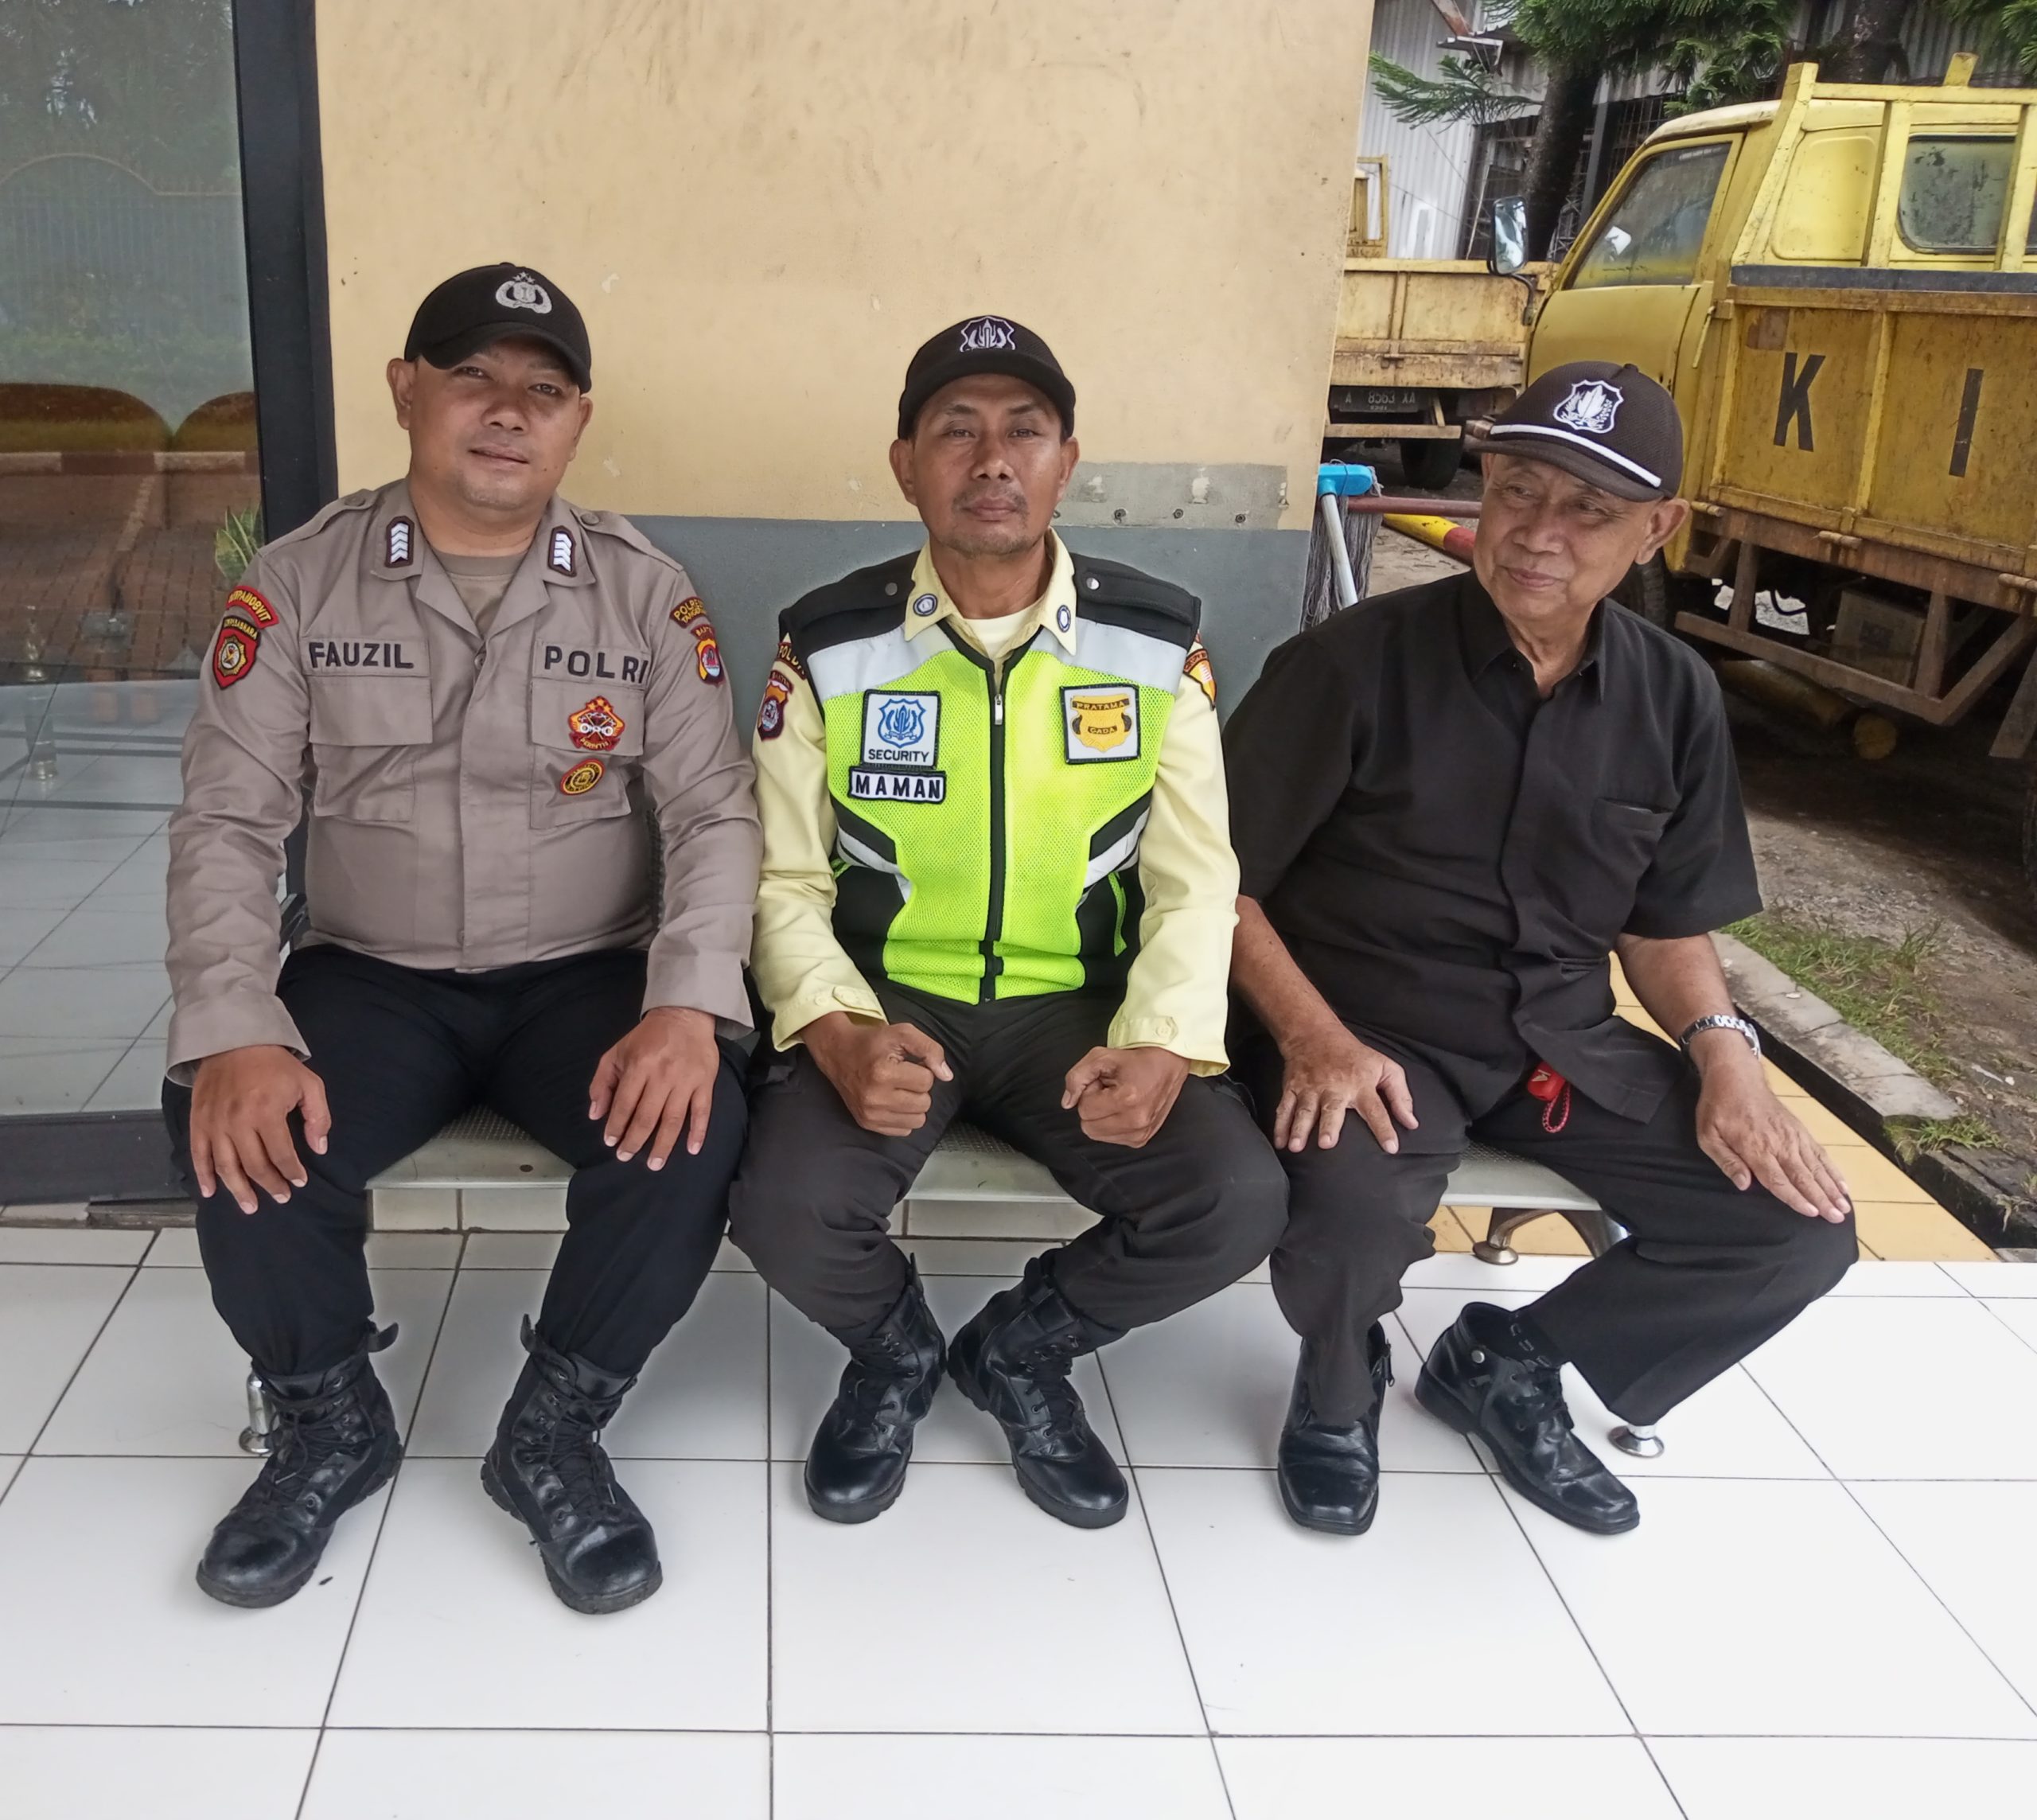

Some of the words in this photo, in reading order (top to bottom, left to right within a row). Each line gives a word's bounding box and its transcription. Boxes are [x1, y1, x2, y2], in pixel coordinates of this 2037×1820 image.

[1346, 392, 1352, 403] A
[1773, 352, 1826, 452] K
[1949, 368, 1984, 477] I
[309, 641, 415, 669] FAUZIL
[544, 645, 648, 684] POLRI
[1077, 701, 1125, 711] PRATAMA
[868, 749, 929, 762] SECURITY
[855, 774, 941, 799] MAMAN
